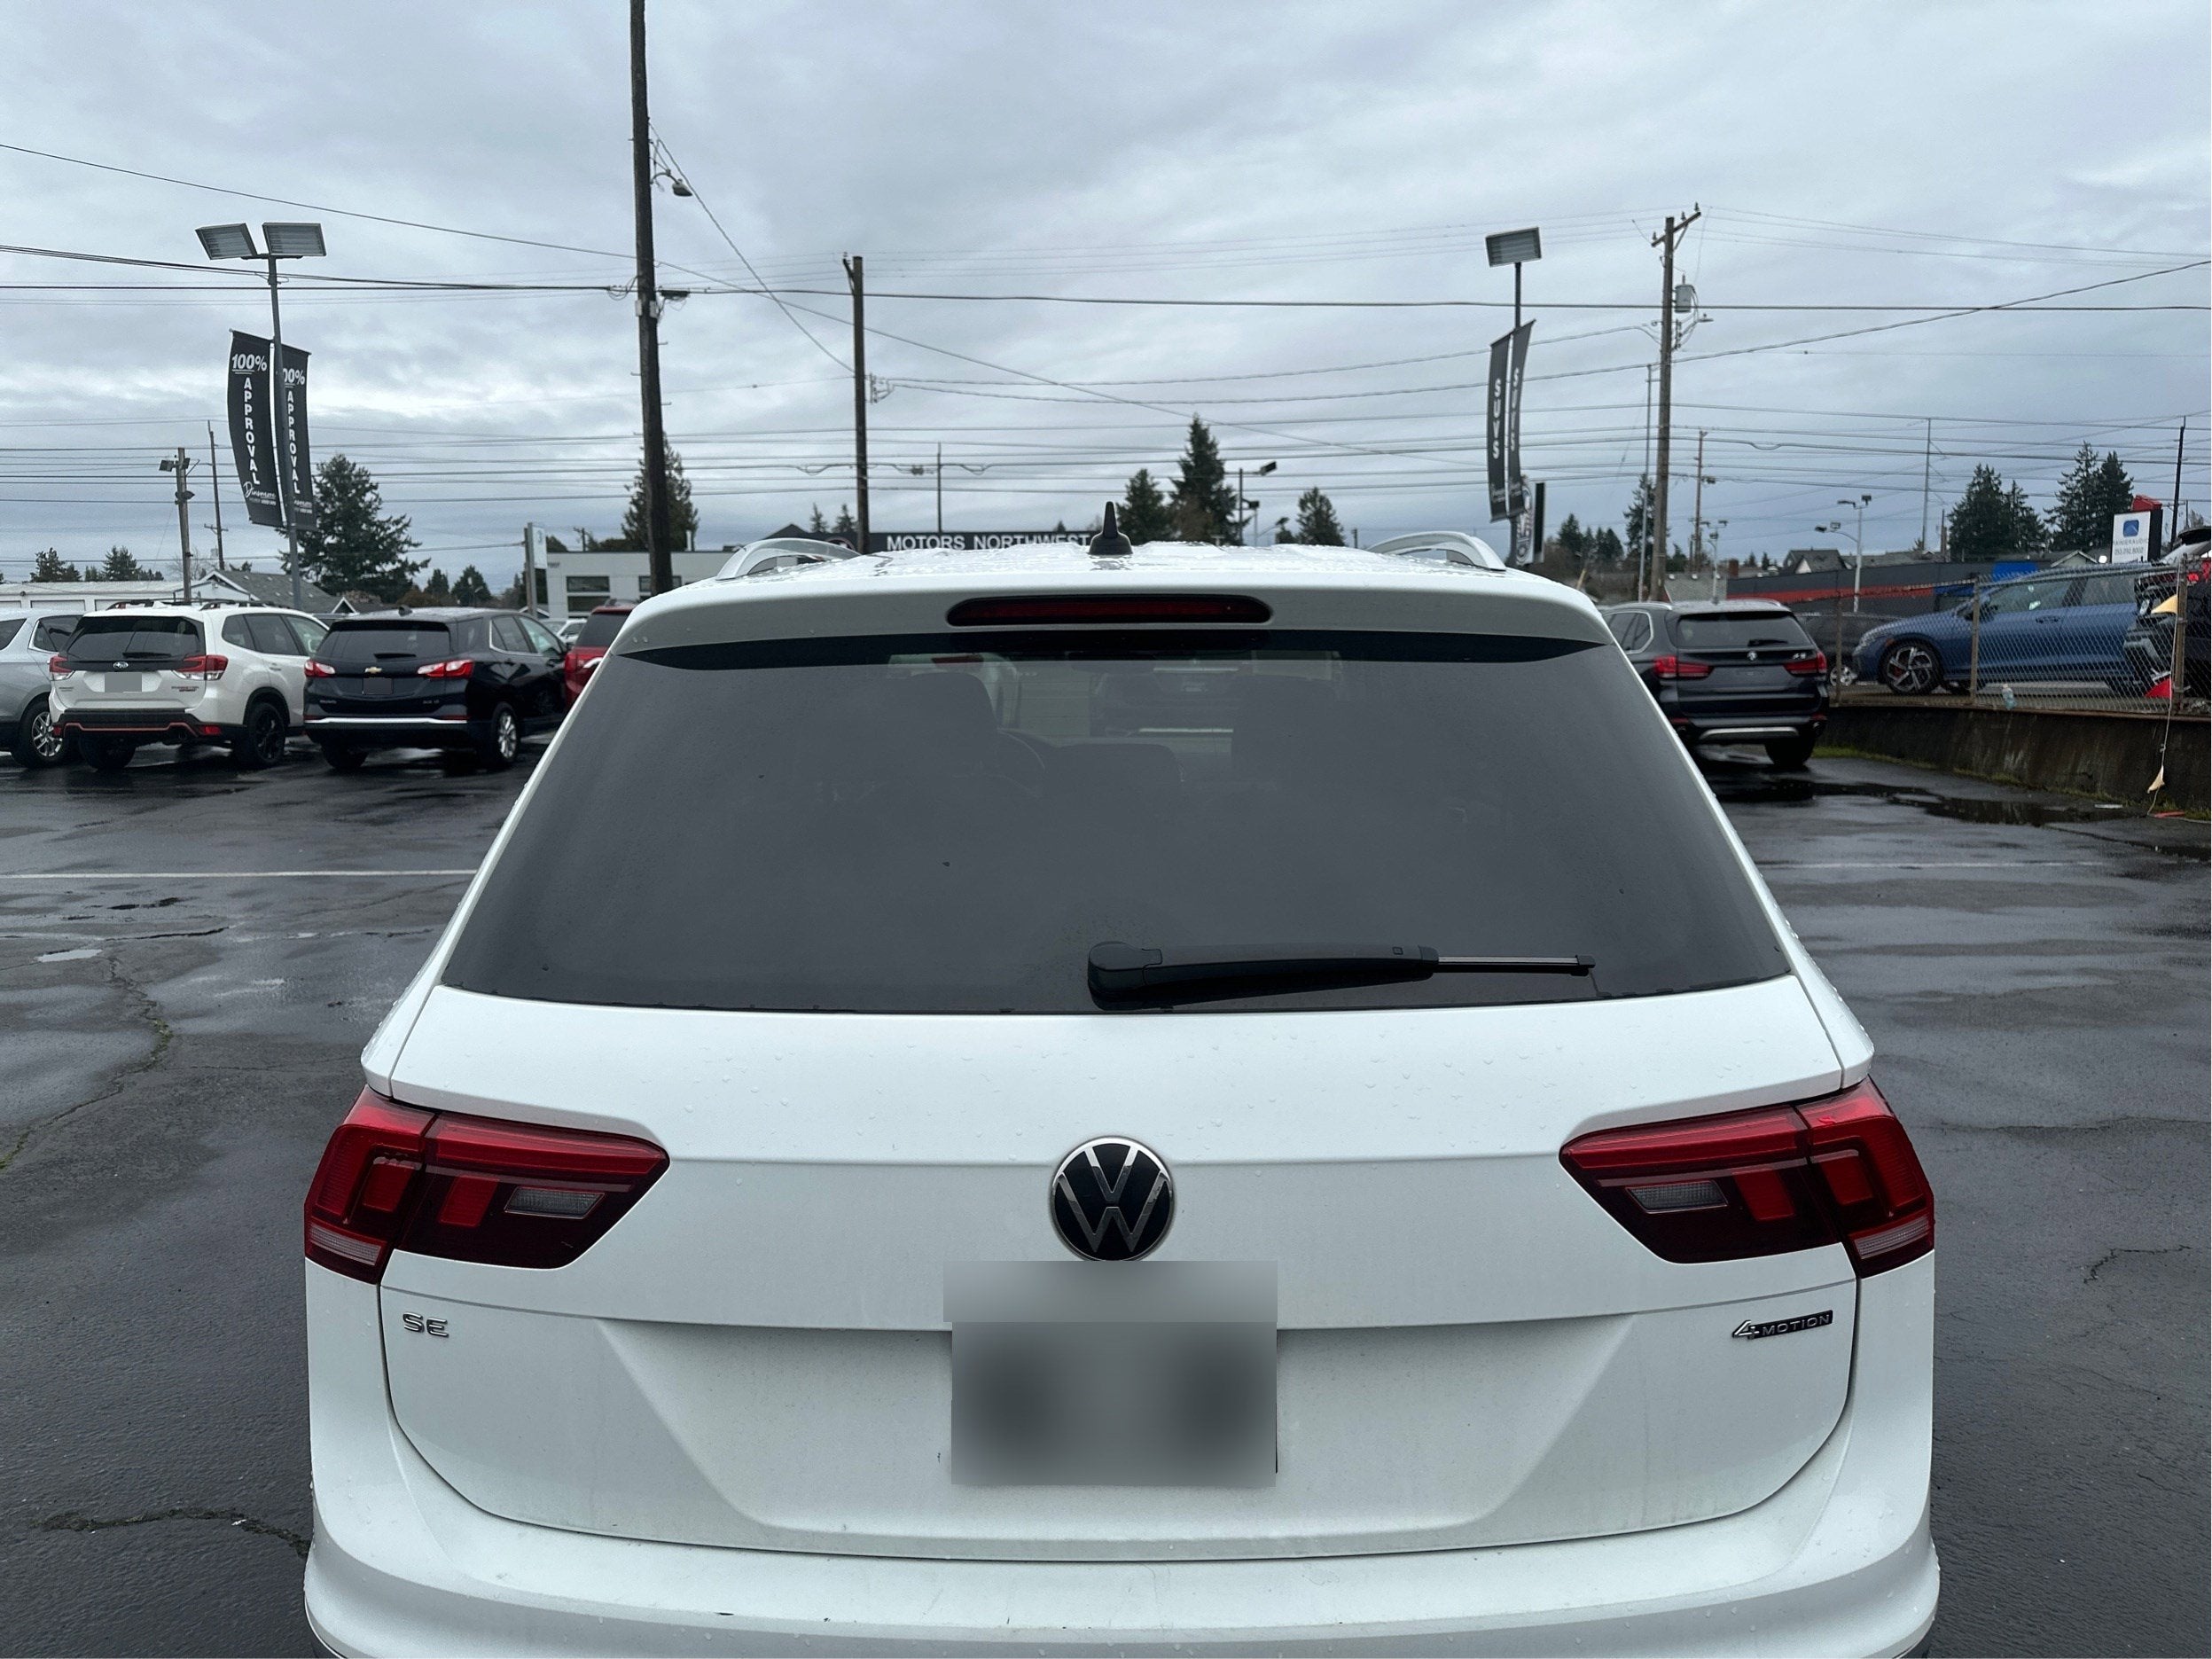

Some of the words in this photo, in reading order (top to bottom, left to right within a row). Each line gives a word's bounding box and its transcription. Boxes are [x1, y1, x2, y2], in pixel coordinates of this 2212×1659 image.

[231, 353, 268, 372] 100%
[282, 368, 306, 385] 00%
[243, 377, 261, 485] APPROVAL
[1492, 378, 1502, 459] SUVS
[287, 390, 301, 494] APPROVAL
[887, 535, 965, 550] MOTORS
[973, 534, 1090, 550] NORTHWEST
[403, 1312, 449, 1338] SE
[1732, 1313, 1831, 1340] 4MOTION
